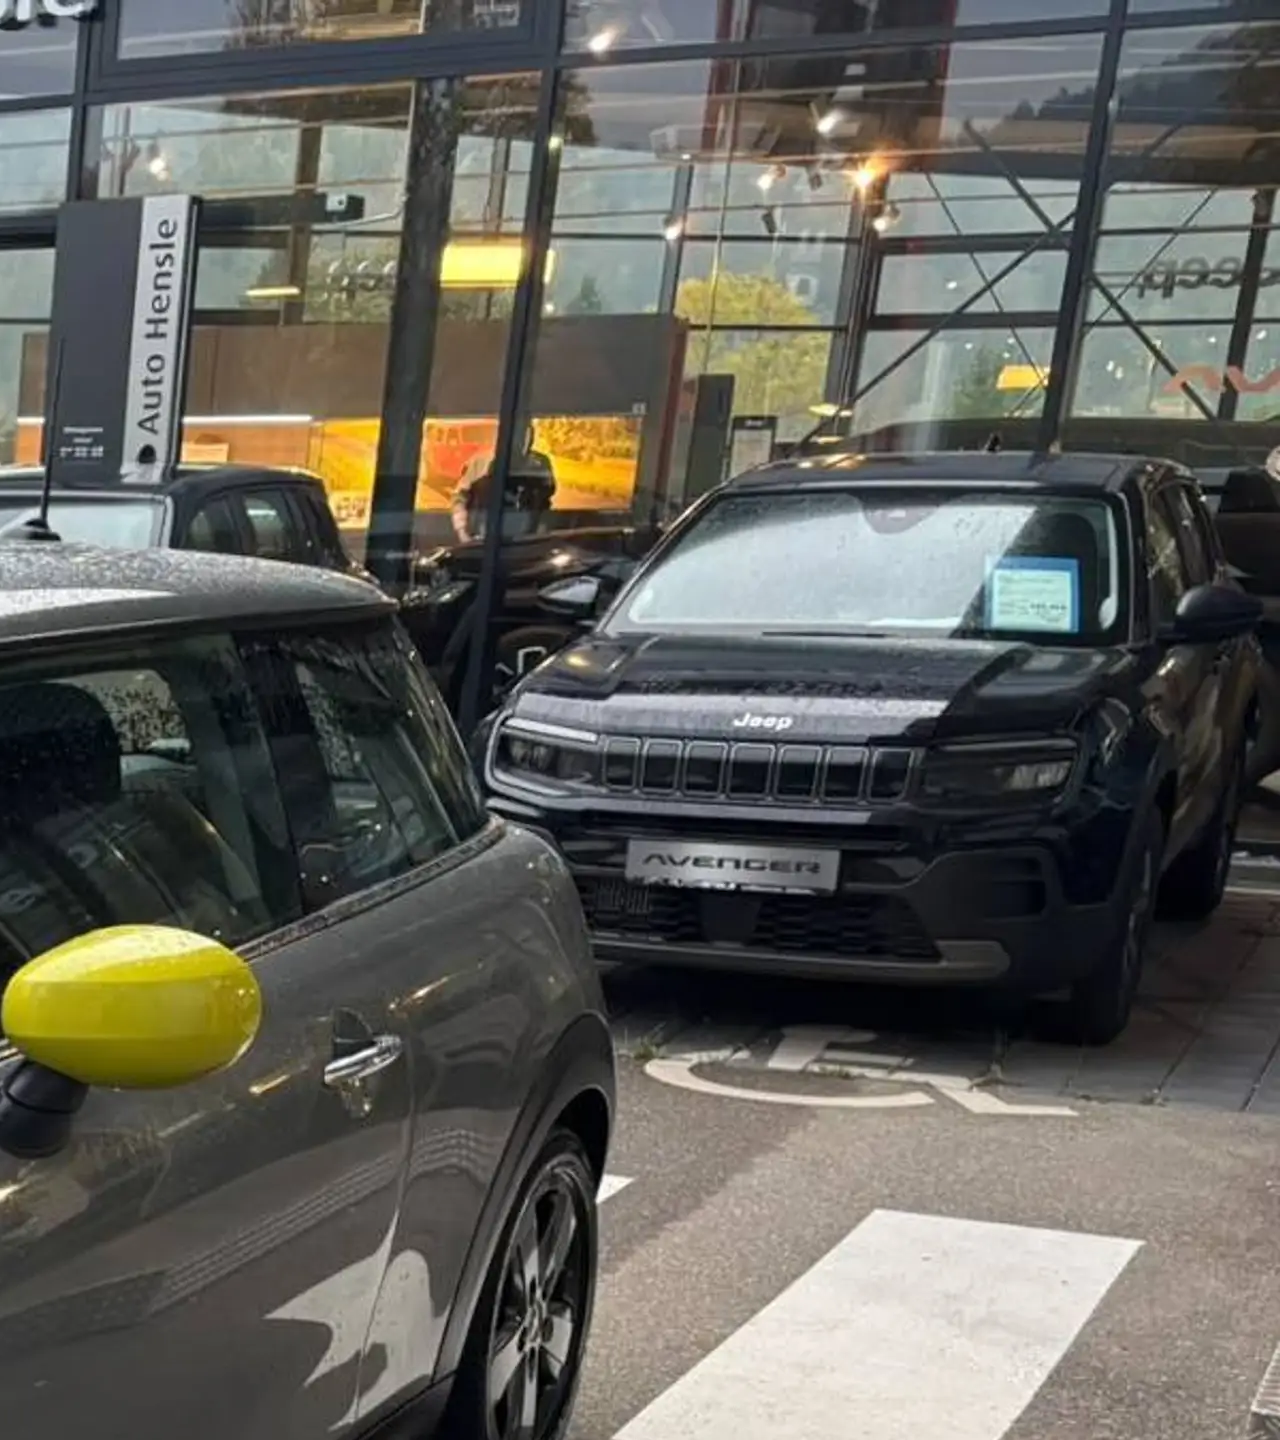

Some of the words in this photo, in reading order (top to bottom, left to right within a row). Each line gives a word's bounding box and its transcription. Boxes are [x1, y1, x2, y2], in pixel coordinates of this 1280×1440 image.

[145, 218, 177, 339] Hensle
[137, 353, 166, 434] Auto
[733, 712, 794, 732] Jeep
[642, 852, 821, 874] AVENGER
